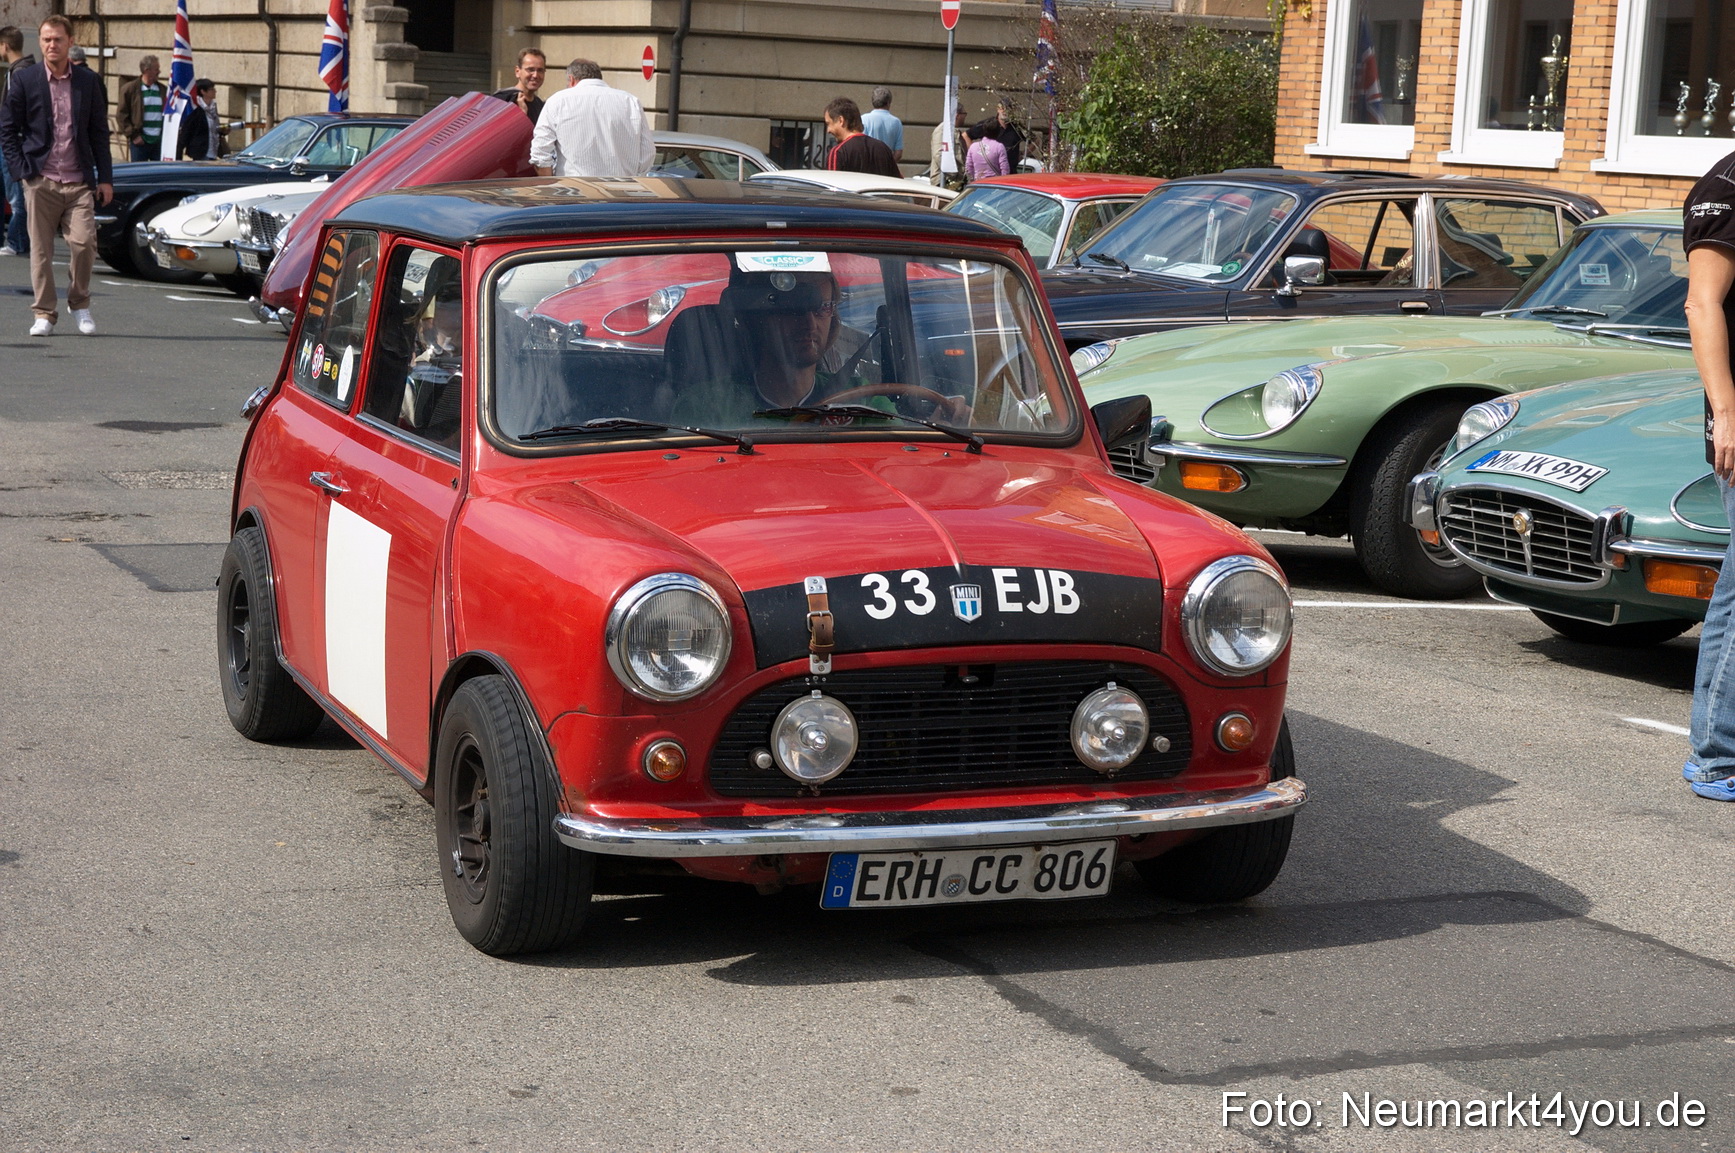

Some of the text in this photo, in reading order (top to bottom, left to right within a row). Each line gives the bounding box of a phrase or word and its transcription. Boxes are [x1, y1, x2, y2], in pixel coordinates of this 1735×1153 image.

[763, 256, 804, 265] CLASSIC
[1482, 452, 1602, 486] NM XK 99H
[860, 568, 1081, 620] 33 EJB
[956, 586, 979, 599] MINI
[832, 847, 1108, 901] D ERH CC 806
